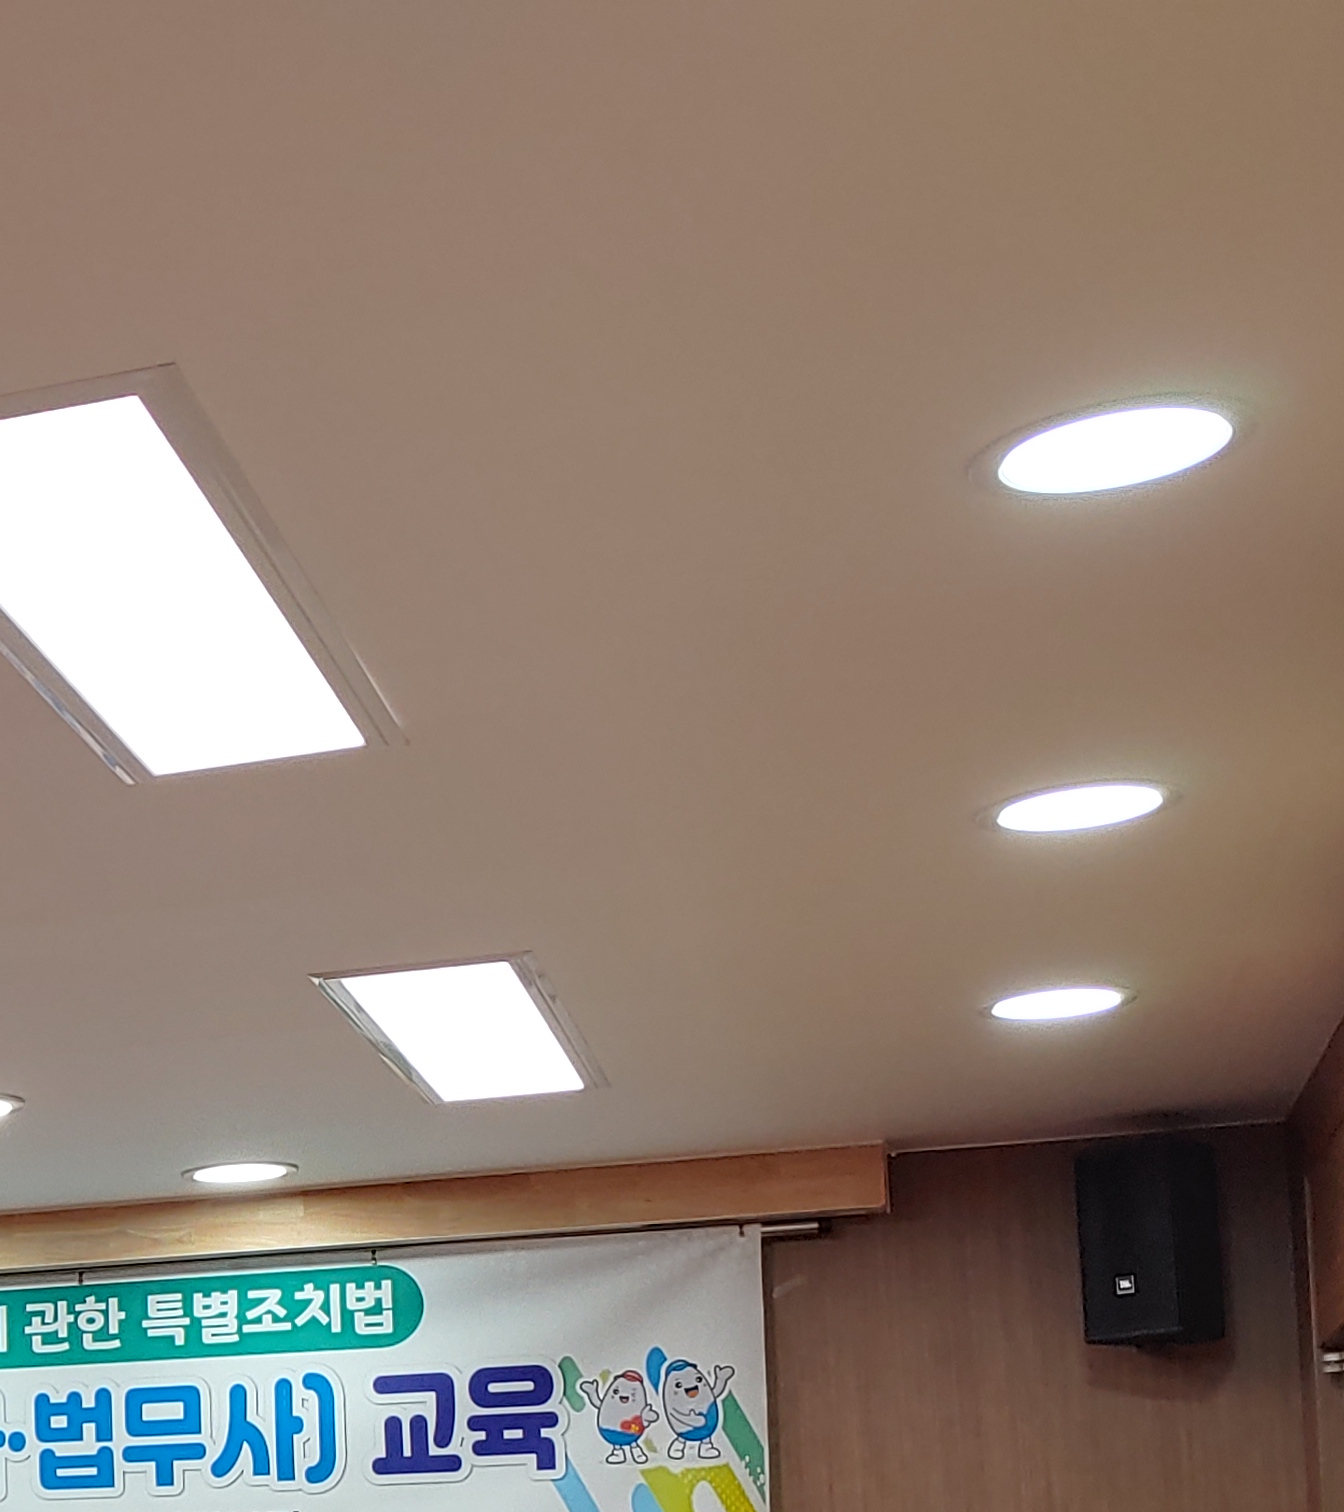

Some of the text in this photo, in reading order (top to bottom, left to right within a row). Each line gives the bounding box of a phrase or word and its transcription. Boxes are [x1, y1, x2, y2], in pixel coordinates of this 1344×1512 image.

[23, 1295, 126, 1354] 관한
[140, 1279, 394, 1346] 특별조치법
[371, 1364, 559, 1474] 교육
